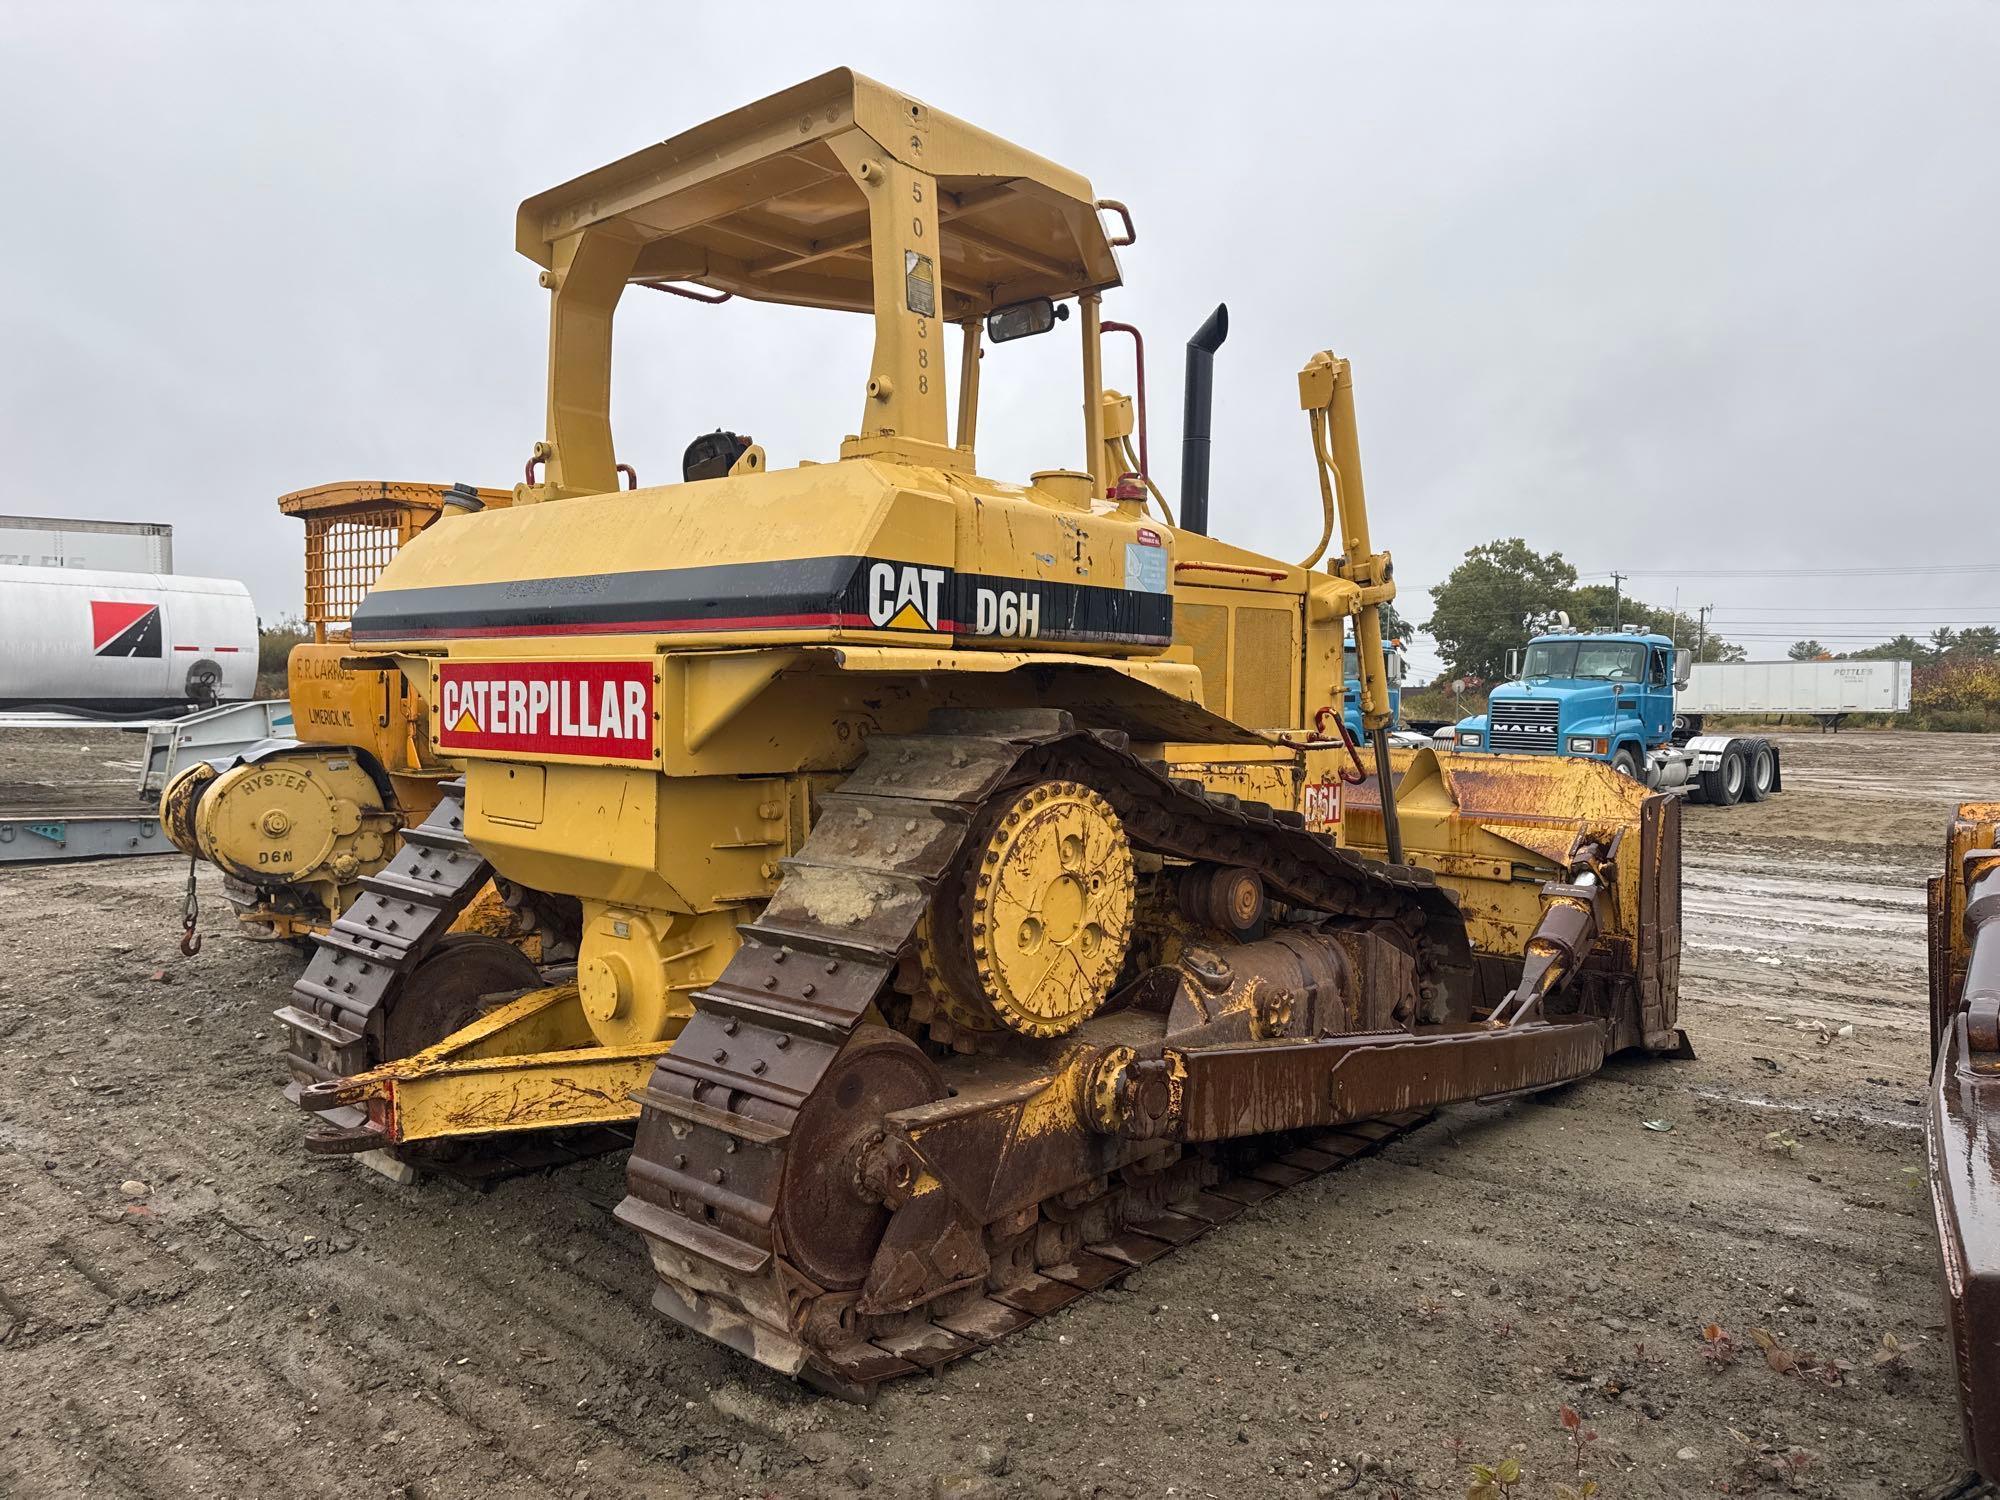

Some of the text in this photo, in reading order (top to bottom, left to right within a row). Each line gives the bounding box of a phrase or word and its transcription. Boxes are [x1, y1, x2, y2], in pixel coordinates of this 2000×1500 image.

[869, 562, 945, 631] CAT
[976, 587, 1040, 638] D6H
[443, 679, 647, 740] CATERPILLAR
[1493, 724, 1555, 733] MACK
[241, 772, 308, 796] HYSTER
[1305, 786, 1341, 822] D6H
